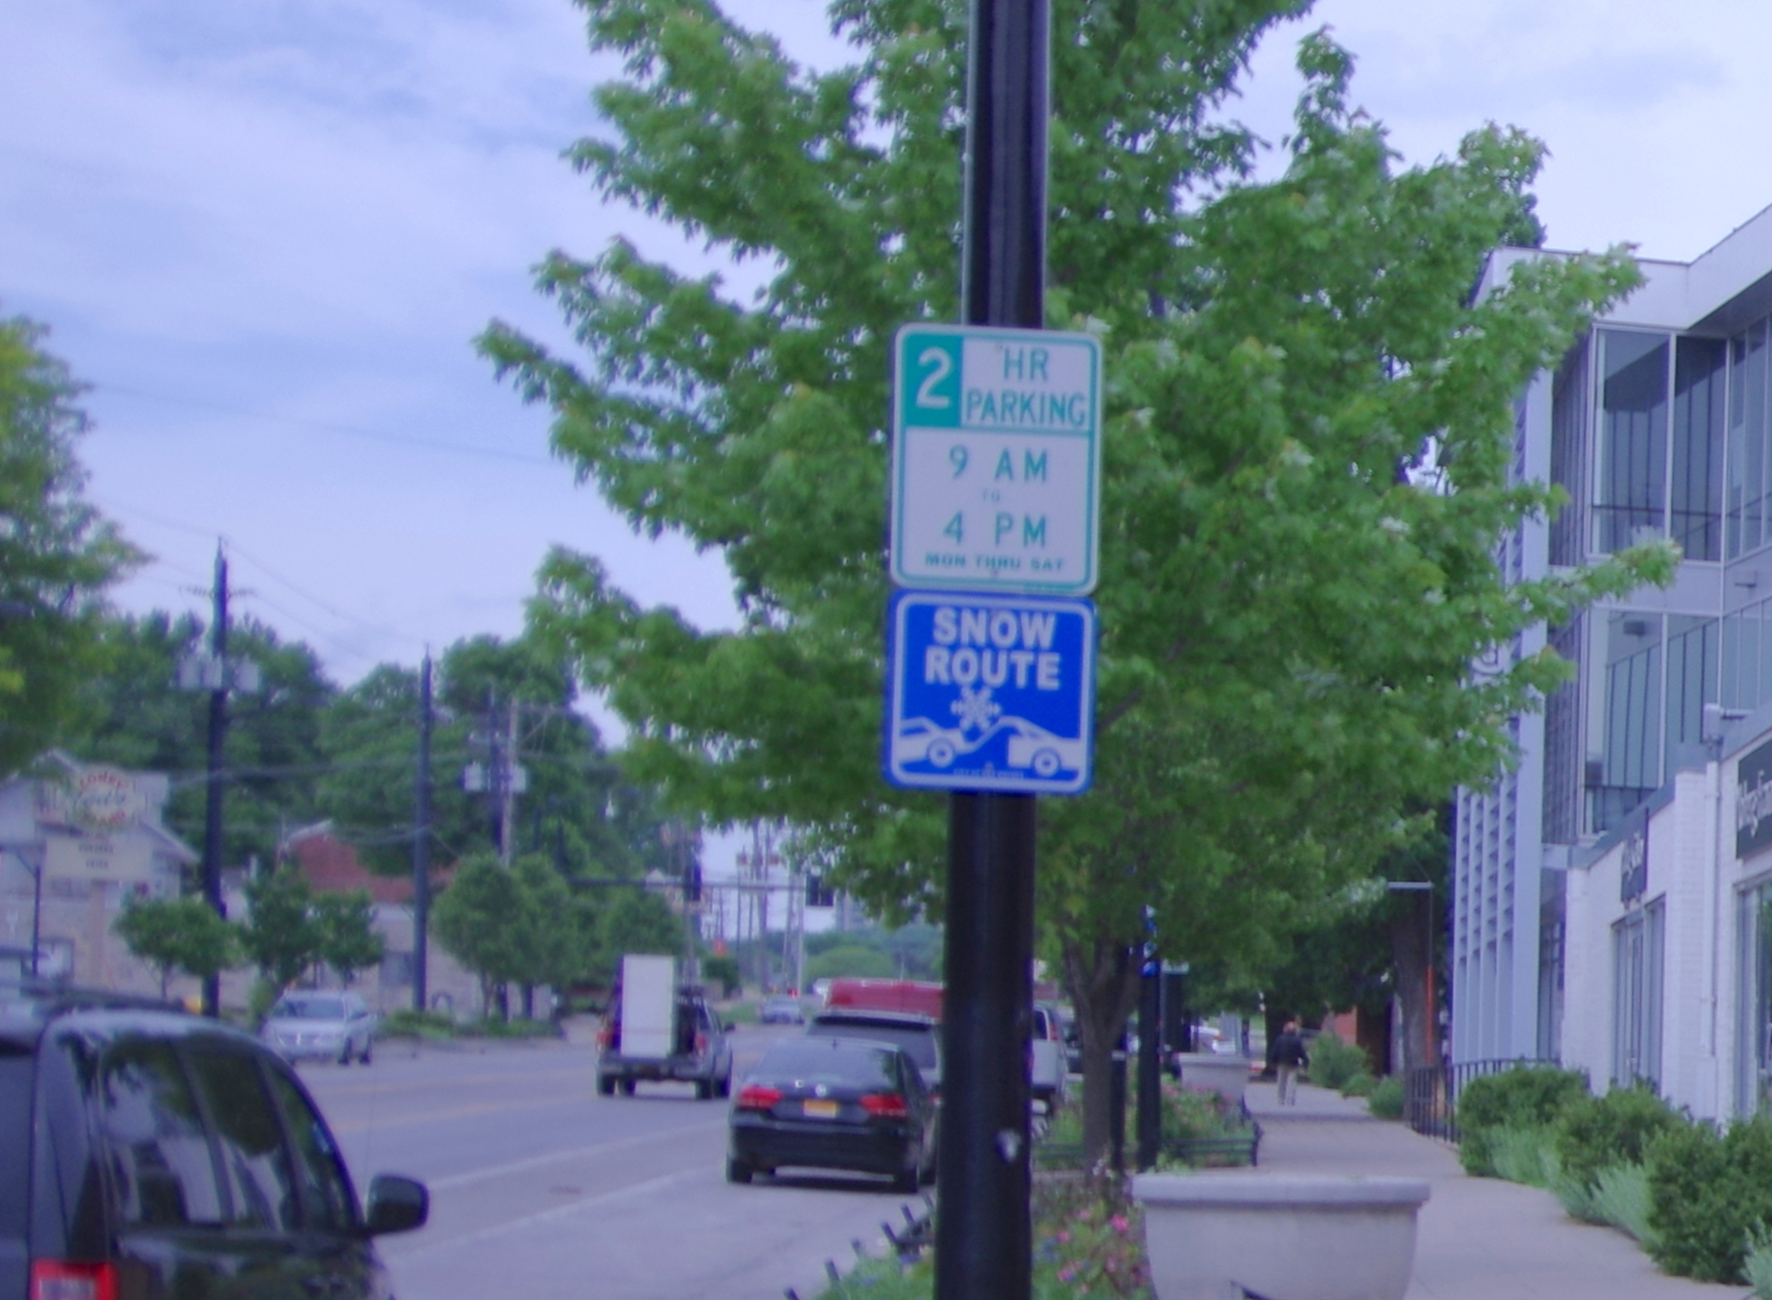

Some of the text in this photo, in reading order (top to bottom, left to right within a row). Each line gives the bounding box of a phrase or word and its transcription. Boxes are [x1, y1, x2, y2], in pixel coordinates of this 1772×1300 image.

[917, 347, 952, 409] 2
[1003, 348, 1048, 382] HR
[966, 389, 1086, 427] PARKING
[950, 444, 968, 479] 9
[944, 510, 963, 544] 4
[934, 607, 1057, 650] SNOW
[925, 648, 1060, 690] ROUTE
